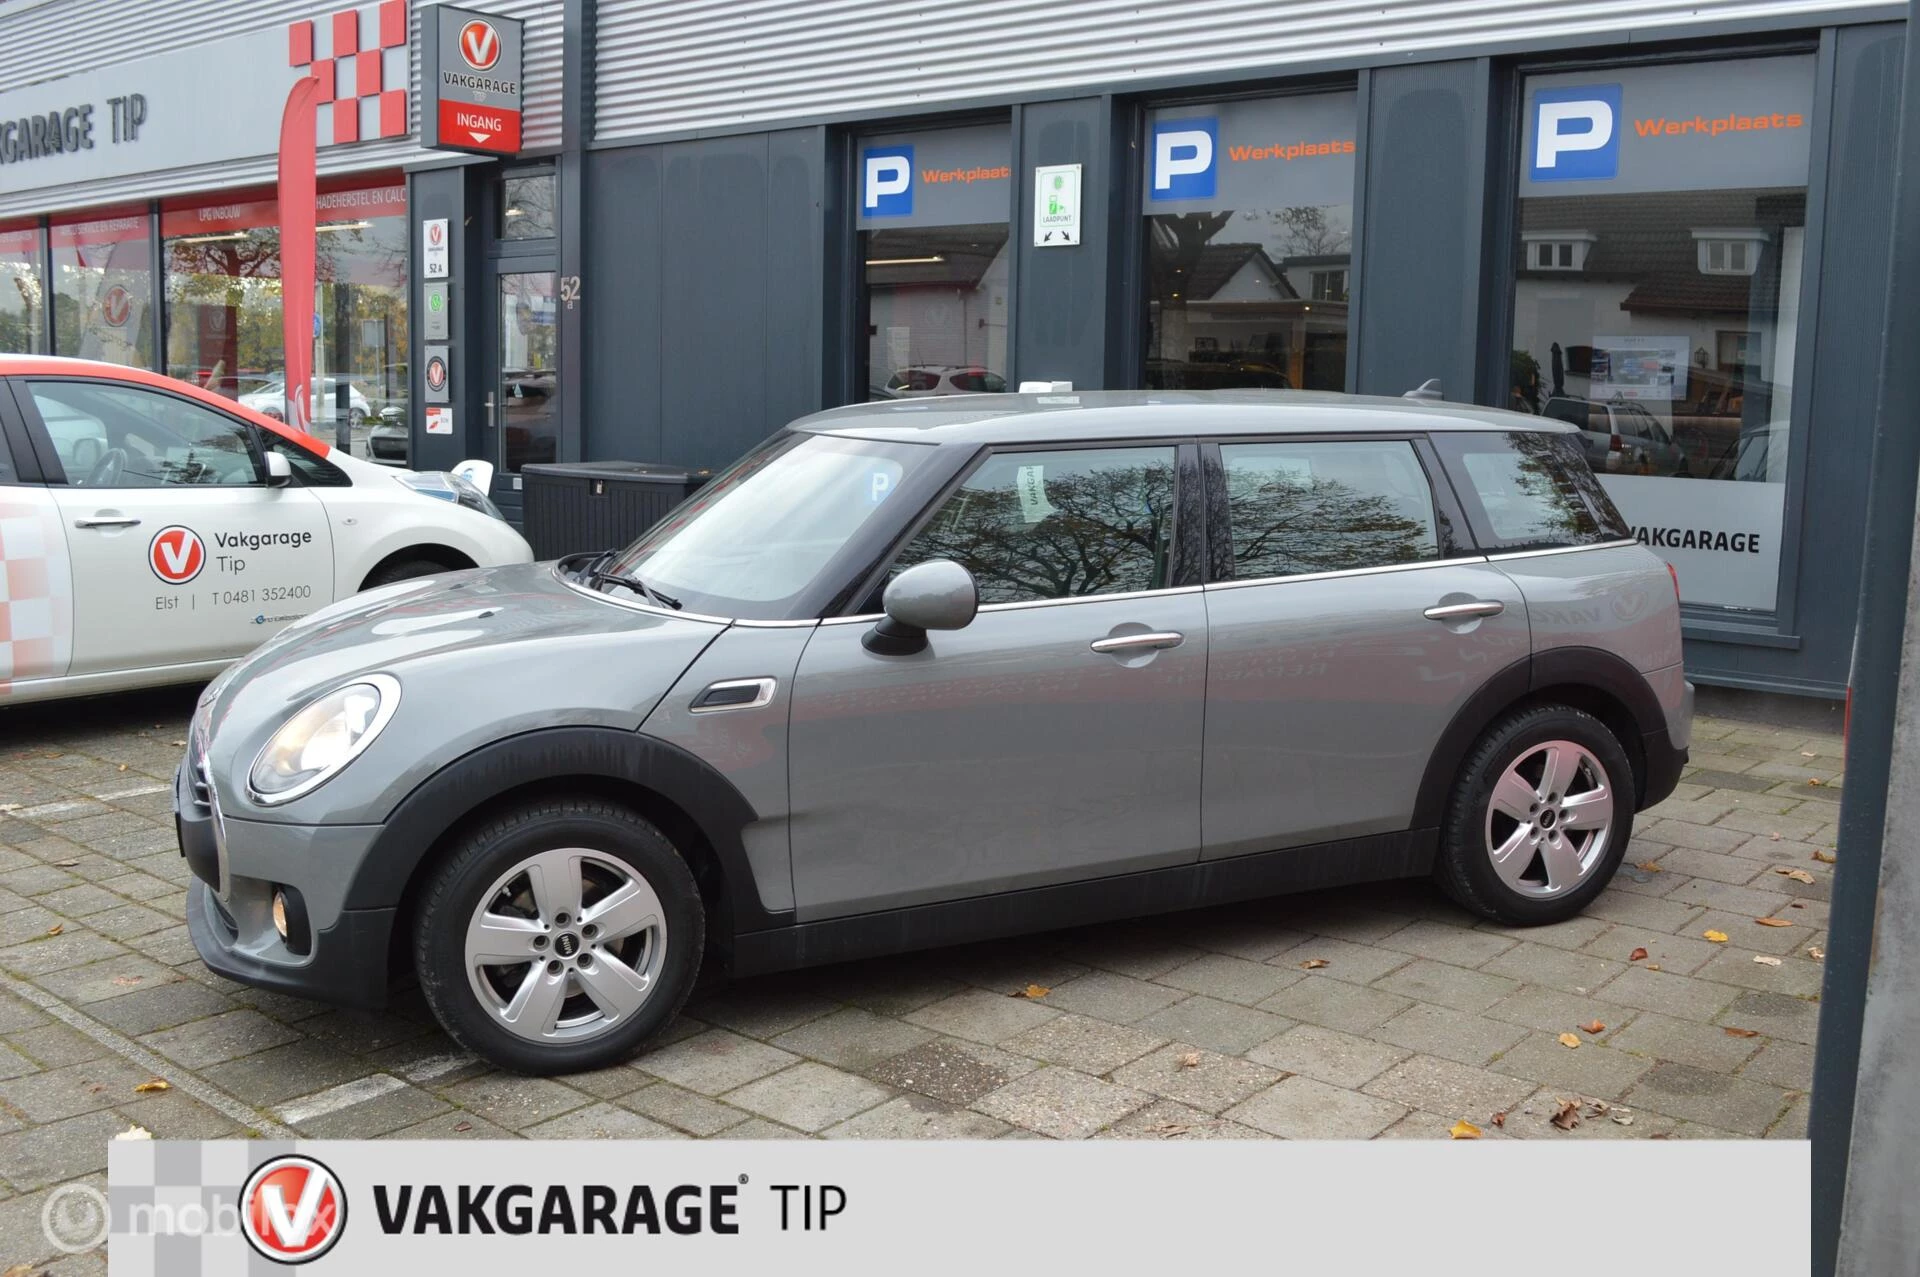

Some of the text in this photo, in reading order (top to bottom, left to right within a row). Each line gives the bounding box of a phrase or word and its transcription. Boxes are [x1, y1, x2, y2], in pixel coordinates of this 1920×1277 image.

[443, 71, 517, 95] VAKGARAGE
[0, 93, 148, 164] GARAGE TIP
[457, 112, 502, 132] INGANG
[1536, 100, 1804, 168] P Werkplaats
[1155, 130, 1356, 190] P Werkplaats
[865, 155, 1011, 207] P Werkplaat
[372, 189, 383, 204] EN
[1043, 214, 1072, 224] LAADPUNT
[429, 263, 443, 273] 52 A
[560, 275, 581, 301] 52
[214, 531, 312, 550] Vakgarage
[216, 555, 246, 575] Tip
[155, 596, 180, 610] Elst
[212, 592, 220, 605] T
[223, 588, 256, 604] 0481
[262, 584, 312, 601] 352400
